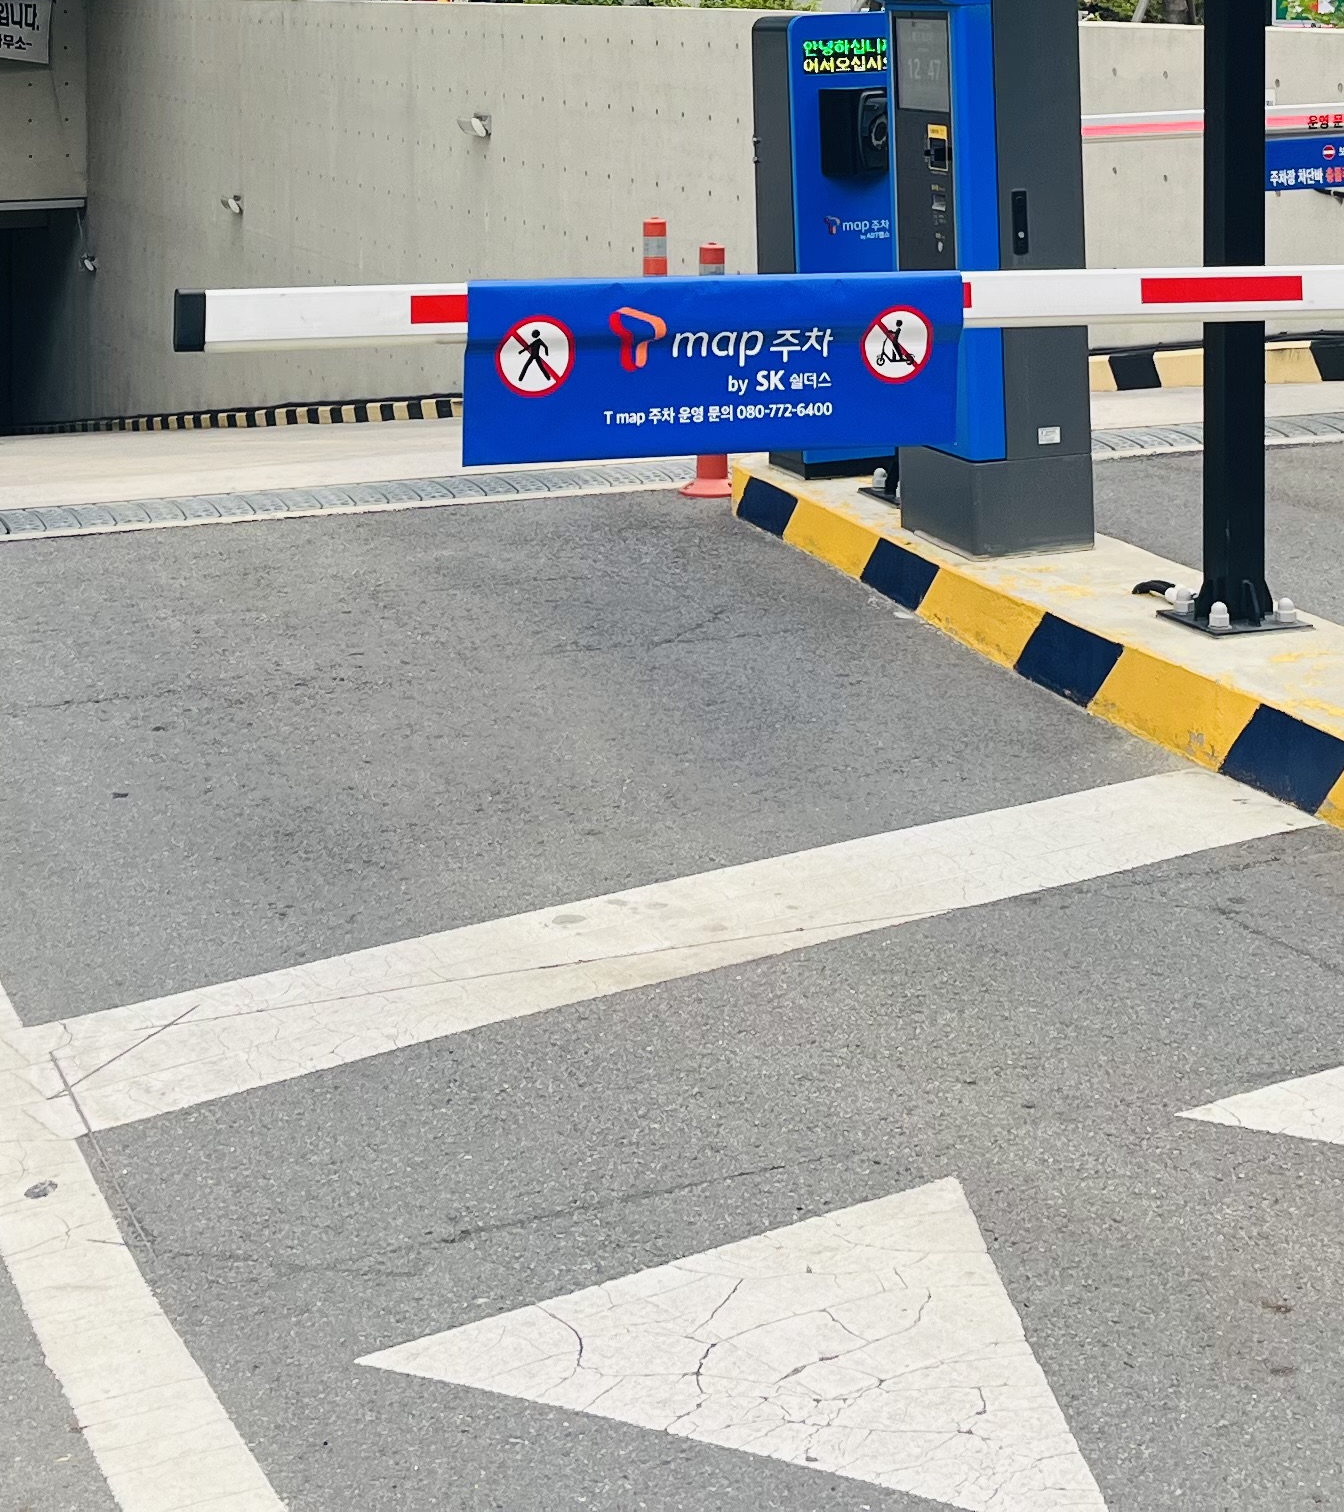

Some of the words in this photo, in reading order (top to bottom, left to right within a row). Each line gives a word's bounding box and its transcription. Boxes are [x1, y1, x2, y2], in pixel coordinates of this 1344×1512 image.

[1307, 115, 1329, 130] 운영
[1270, 170, 1295, 187] 주차장
[842, 220, 870, 233] map
[871, 219, 890, 231] 주차
[672, 327, 764, 367] map
[769, 326, 834, 364] 주차
[727, 374, 748, 396] by
[756, 370, 786, 392] SK
[789, 371, 832, 391] 쉴더스
[604, 411, 615, 425] T
[616, 412, 646, 427] map
[648, 408, 675, 426] 주차
[678, 405, 704, 425] 운영
[707, 404, 733, 424] 문의
[736, 401, 833, 421] 080-772-6400
